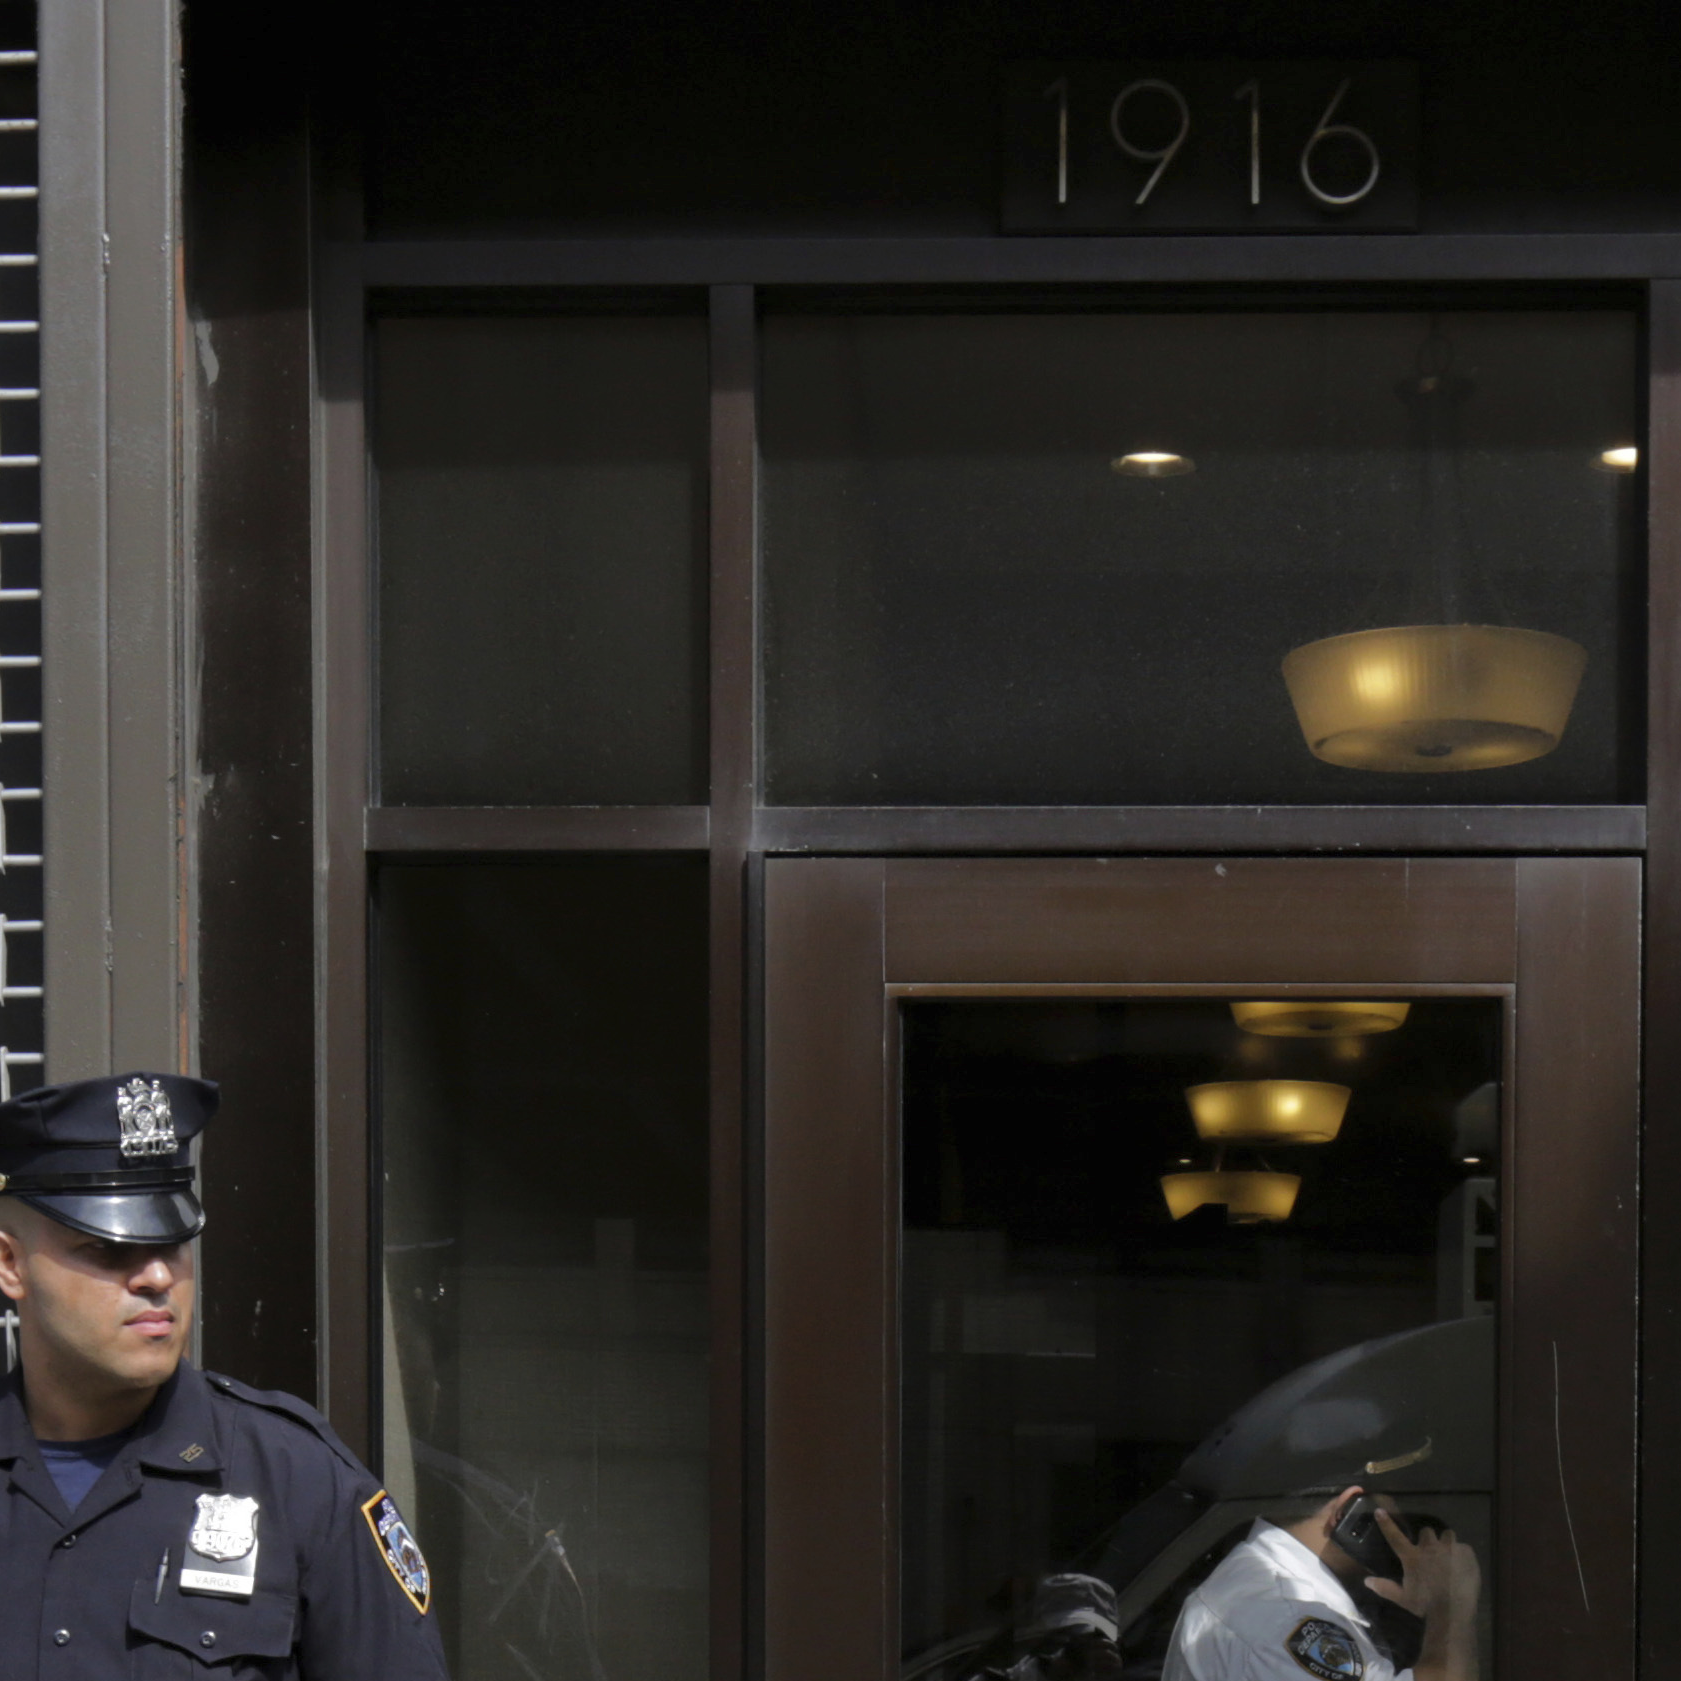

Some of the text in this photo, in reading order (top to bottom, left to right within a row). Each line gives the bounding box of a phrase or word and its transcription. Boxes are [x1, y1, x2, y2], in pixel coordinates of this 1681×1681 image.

[1043, 77, 1380, 205] 1916
[194, 1575, 240, 1589] VARGAS
[1309, 1662, 1331, 1678] CITY
